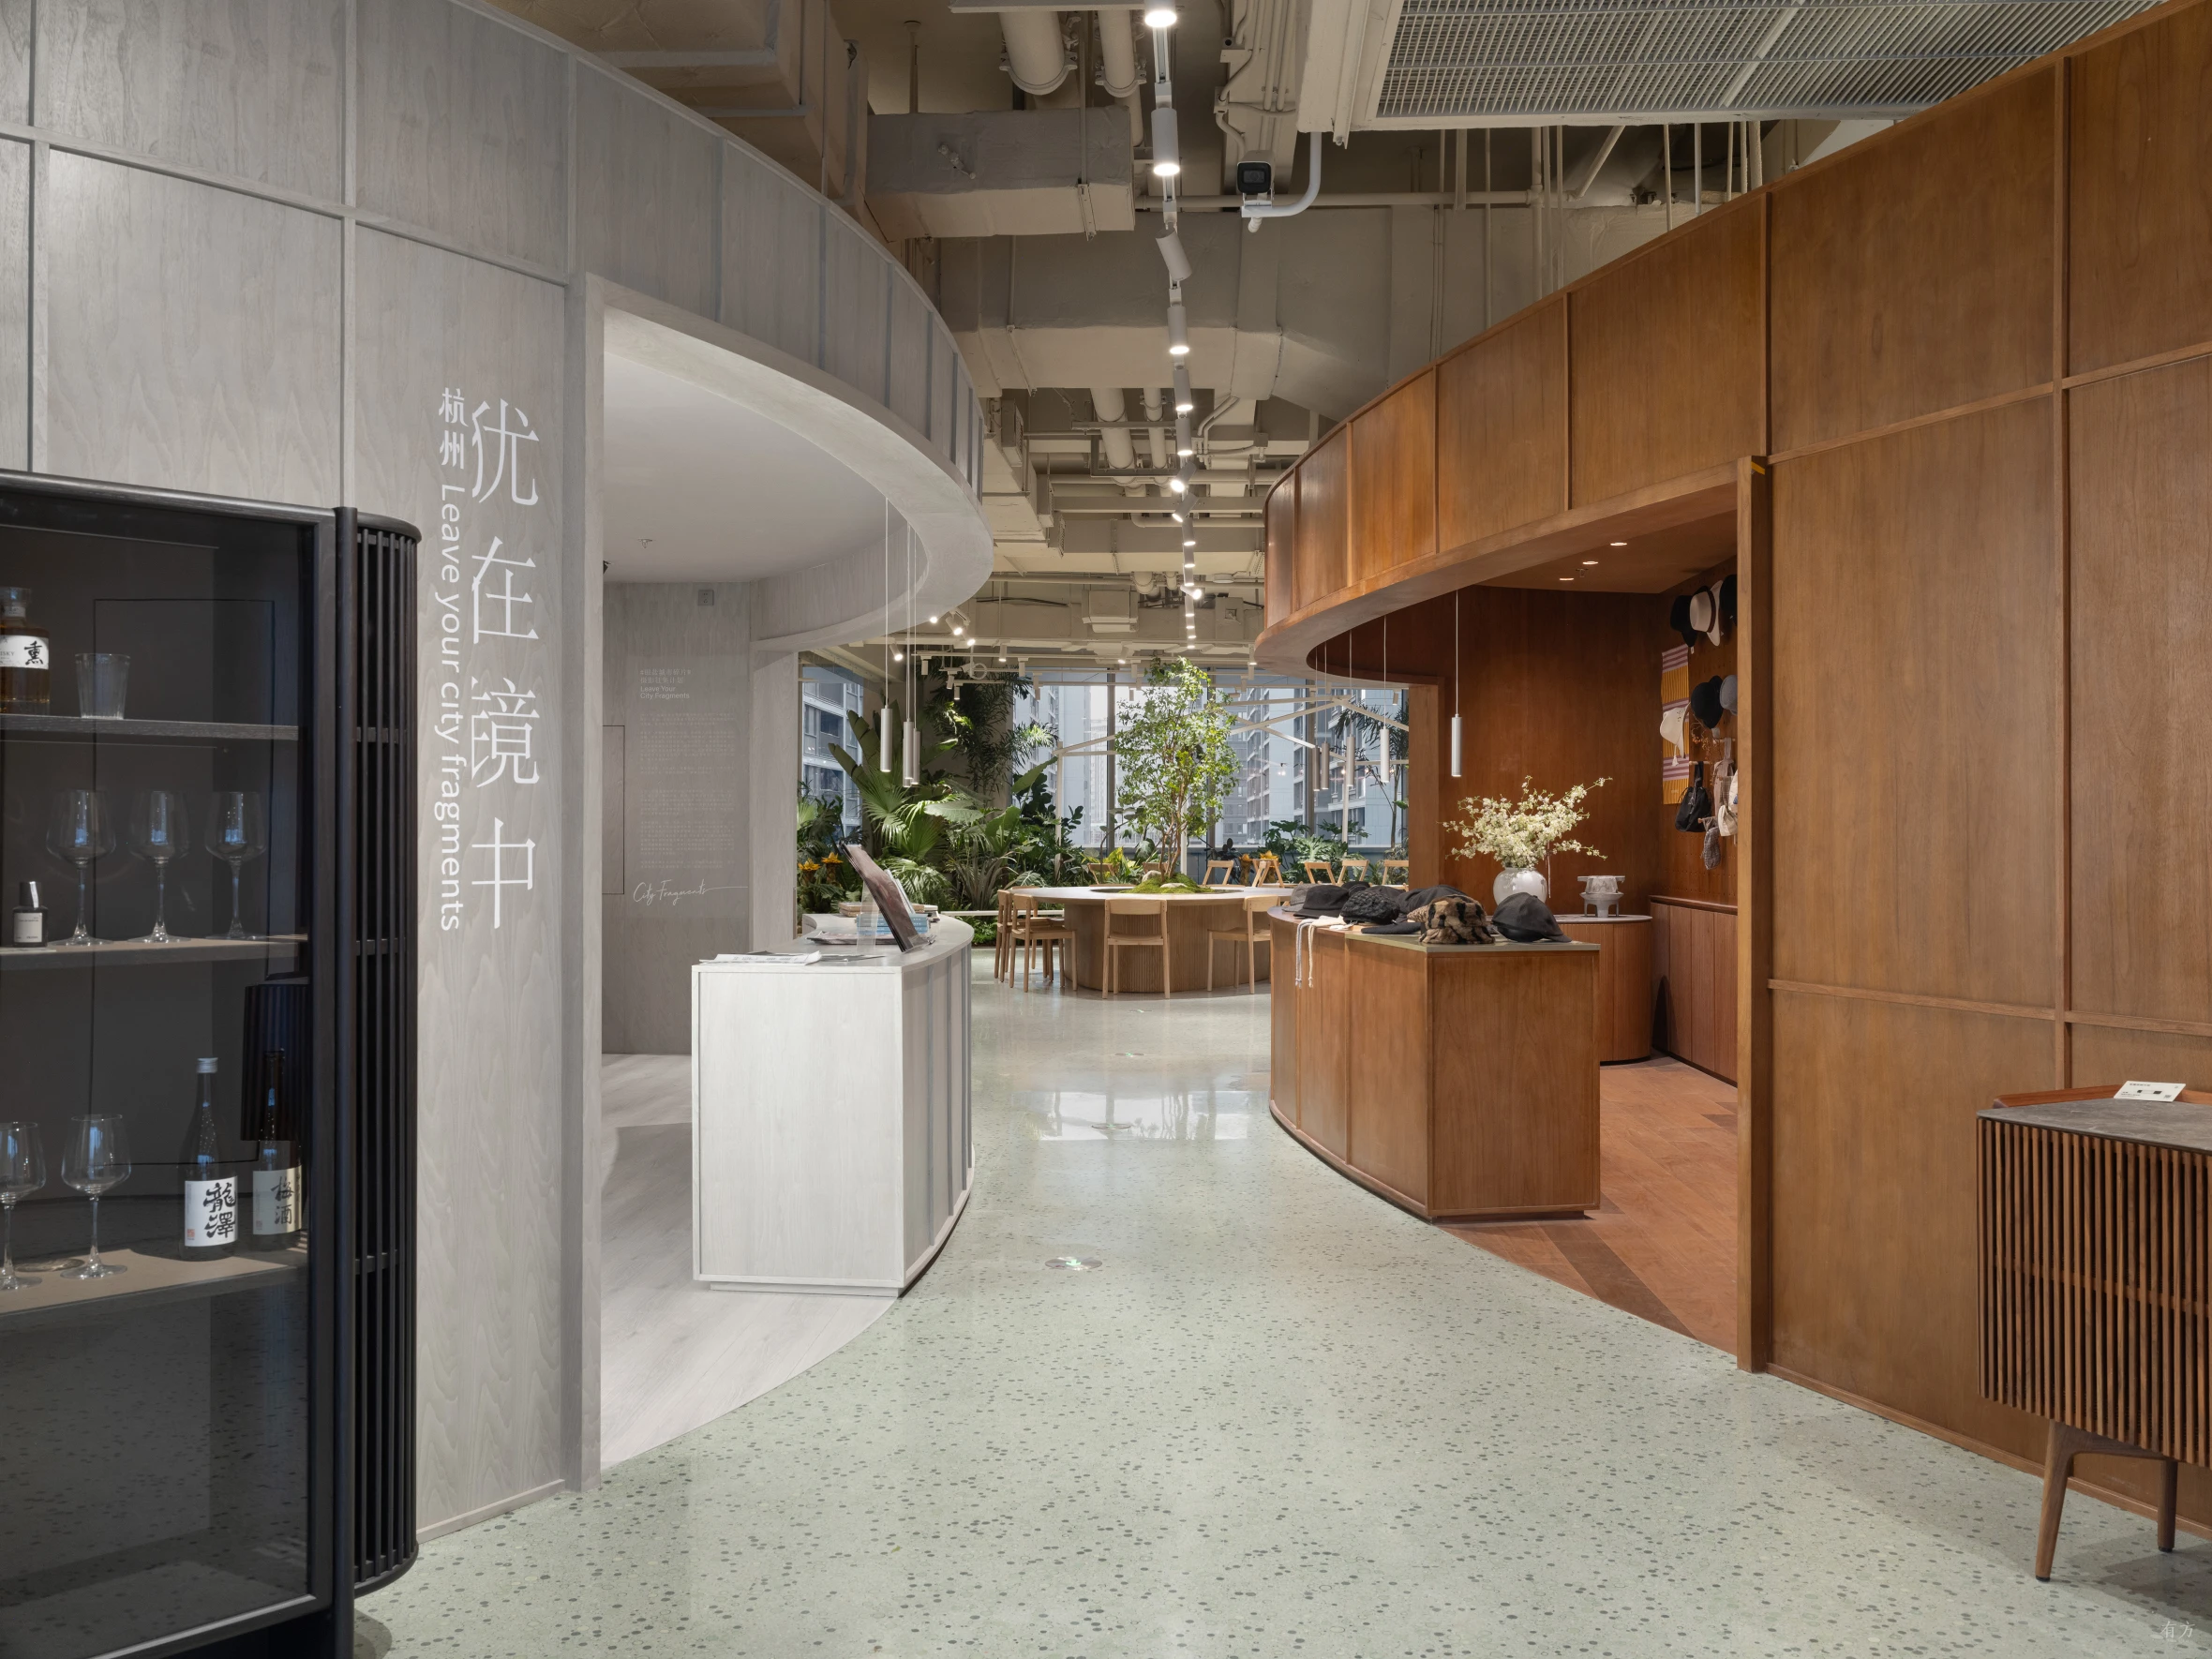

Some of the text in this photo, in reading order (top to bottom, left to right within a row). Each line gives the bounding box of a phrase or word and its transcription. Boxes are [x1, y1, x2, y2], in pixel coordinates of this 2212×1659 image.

[438, 387, 469, 470] 杭州
[441, 484, 466, 583] Leave
[434, 591, 460, 673] your
[434, 754, 468, 931] fragments
[633, 878, 705, 905] City Fragments
